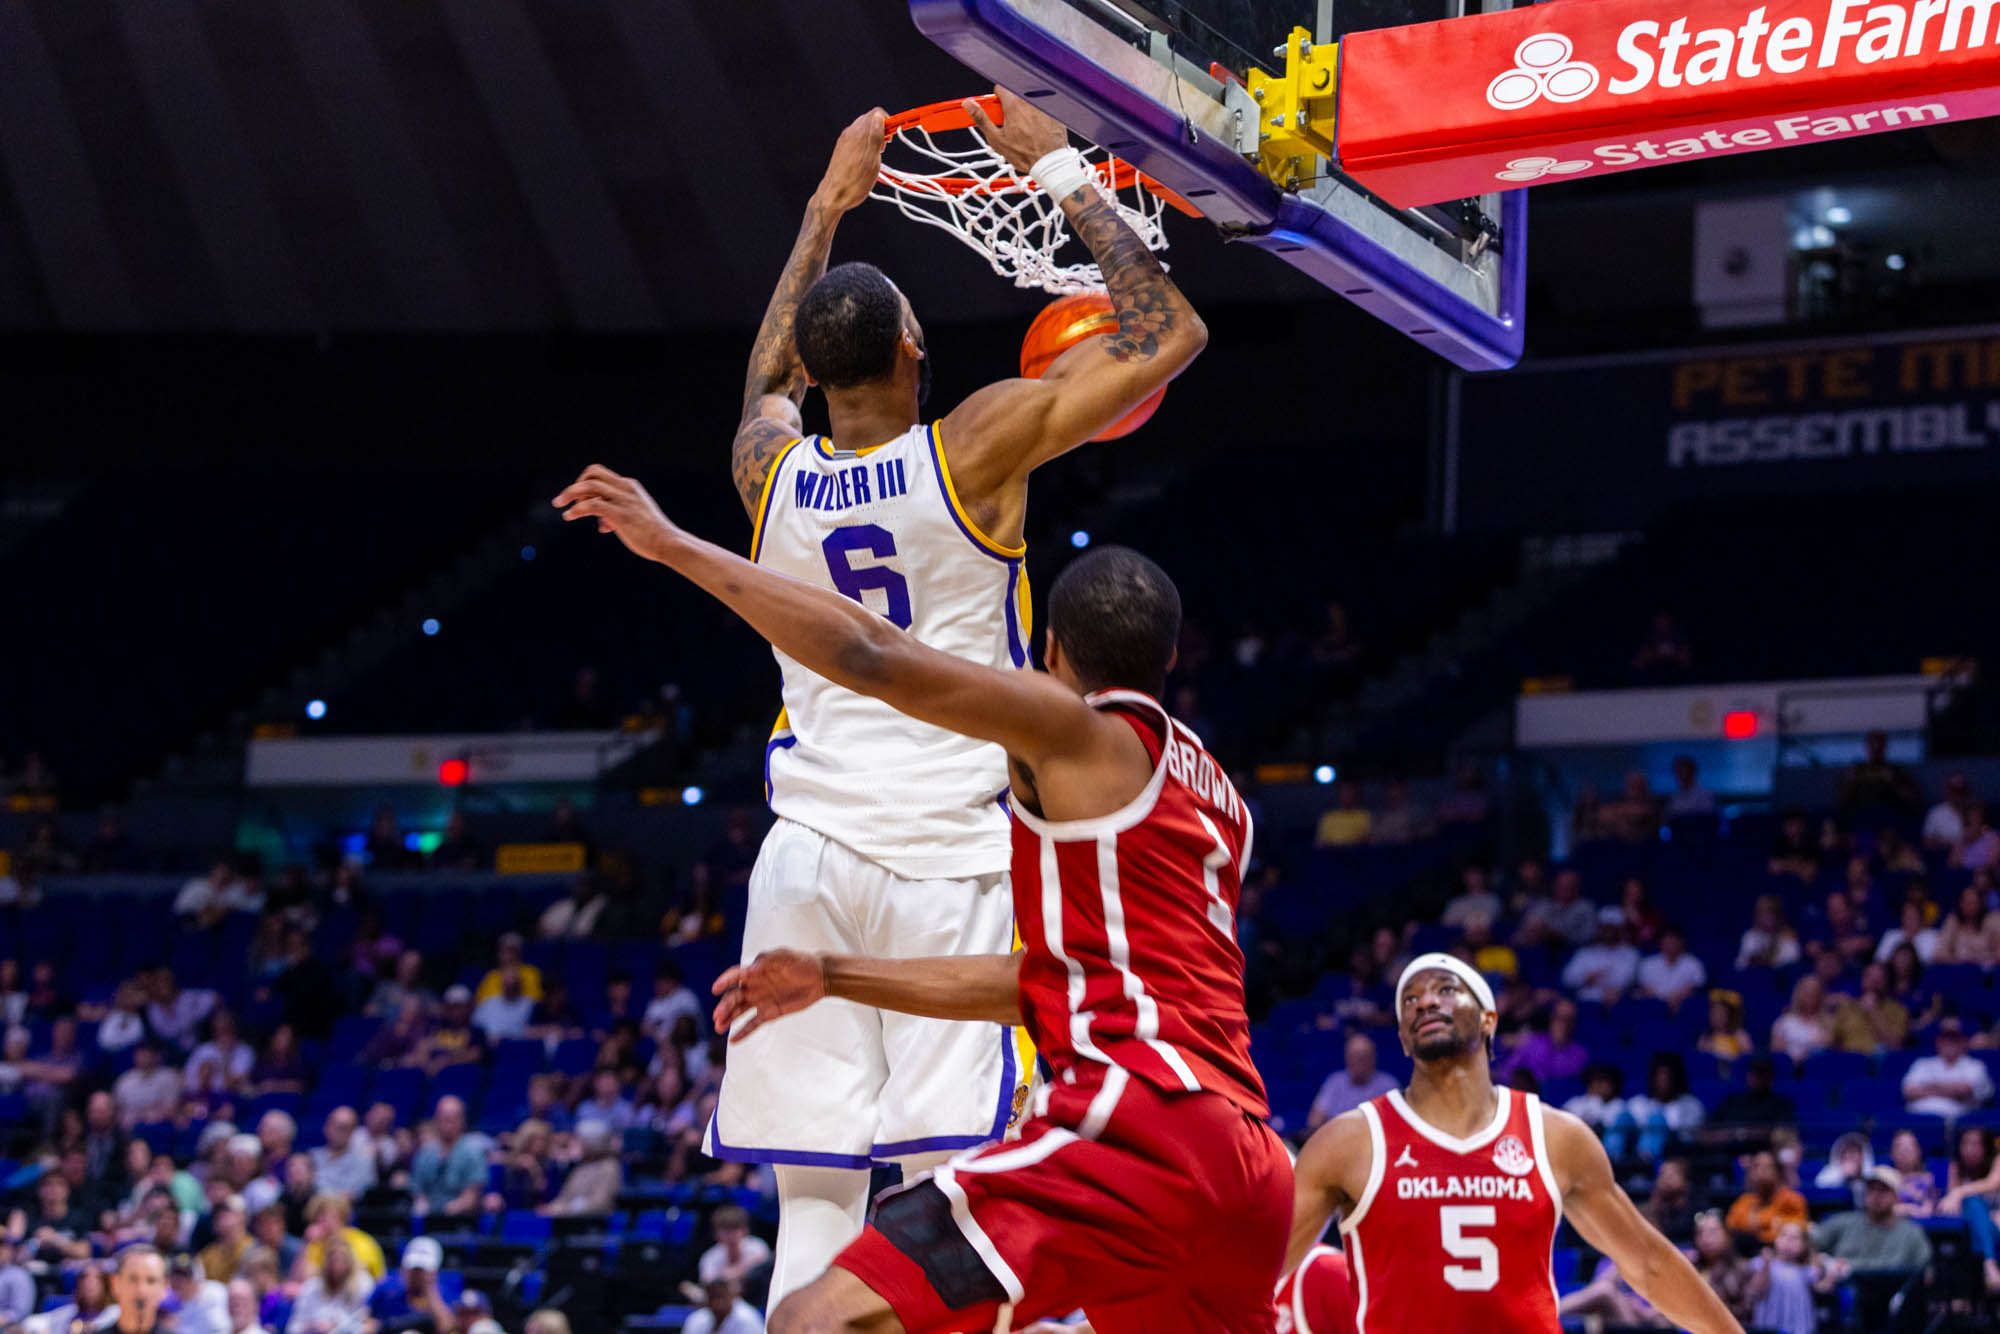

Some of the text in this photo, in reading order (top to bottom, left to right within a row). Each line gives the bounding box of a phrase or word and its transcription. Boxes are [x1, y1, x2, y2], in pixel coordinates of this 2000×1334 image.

[1670, 348, 1874, 409] PETE
[796, 459, 907, 511] MILLER III
[822, 524, 912, 631] 6
[1168, 739, 1240, 826] BROWN
[1397, 1176, 1534, 1202] OKLAHOMA
[1440, 1205, 1499, 1291] 5
